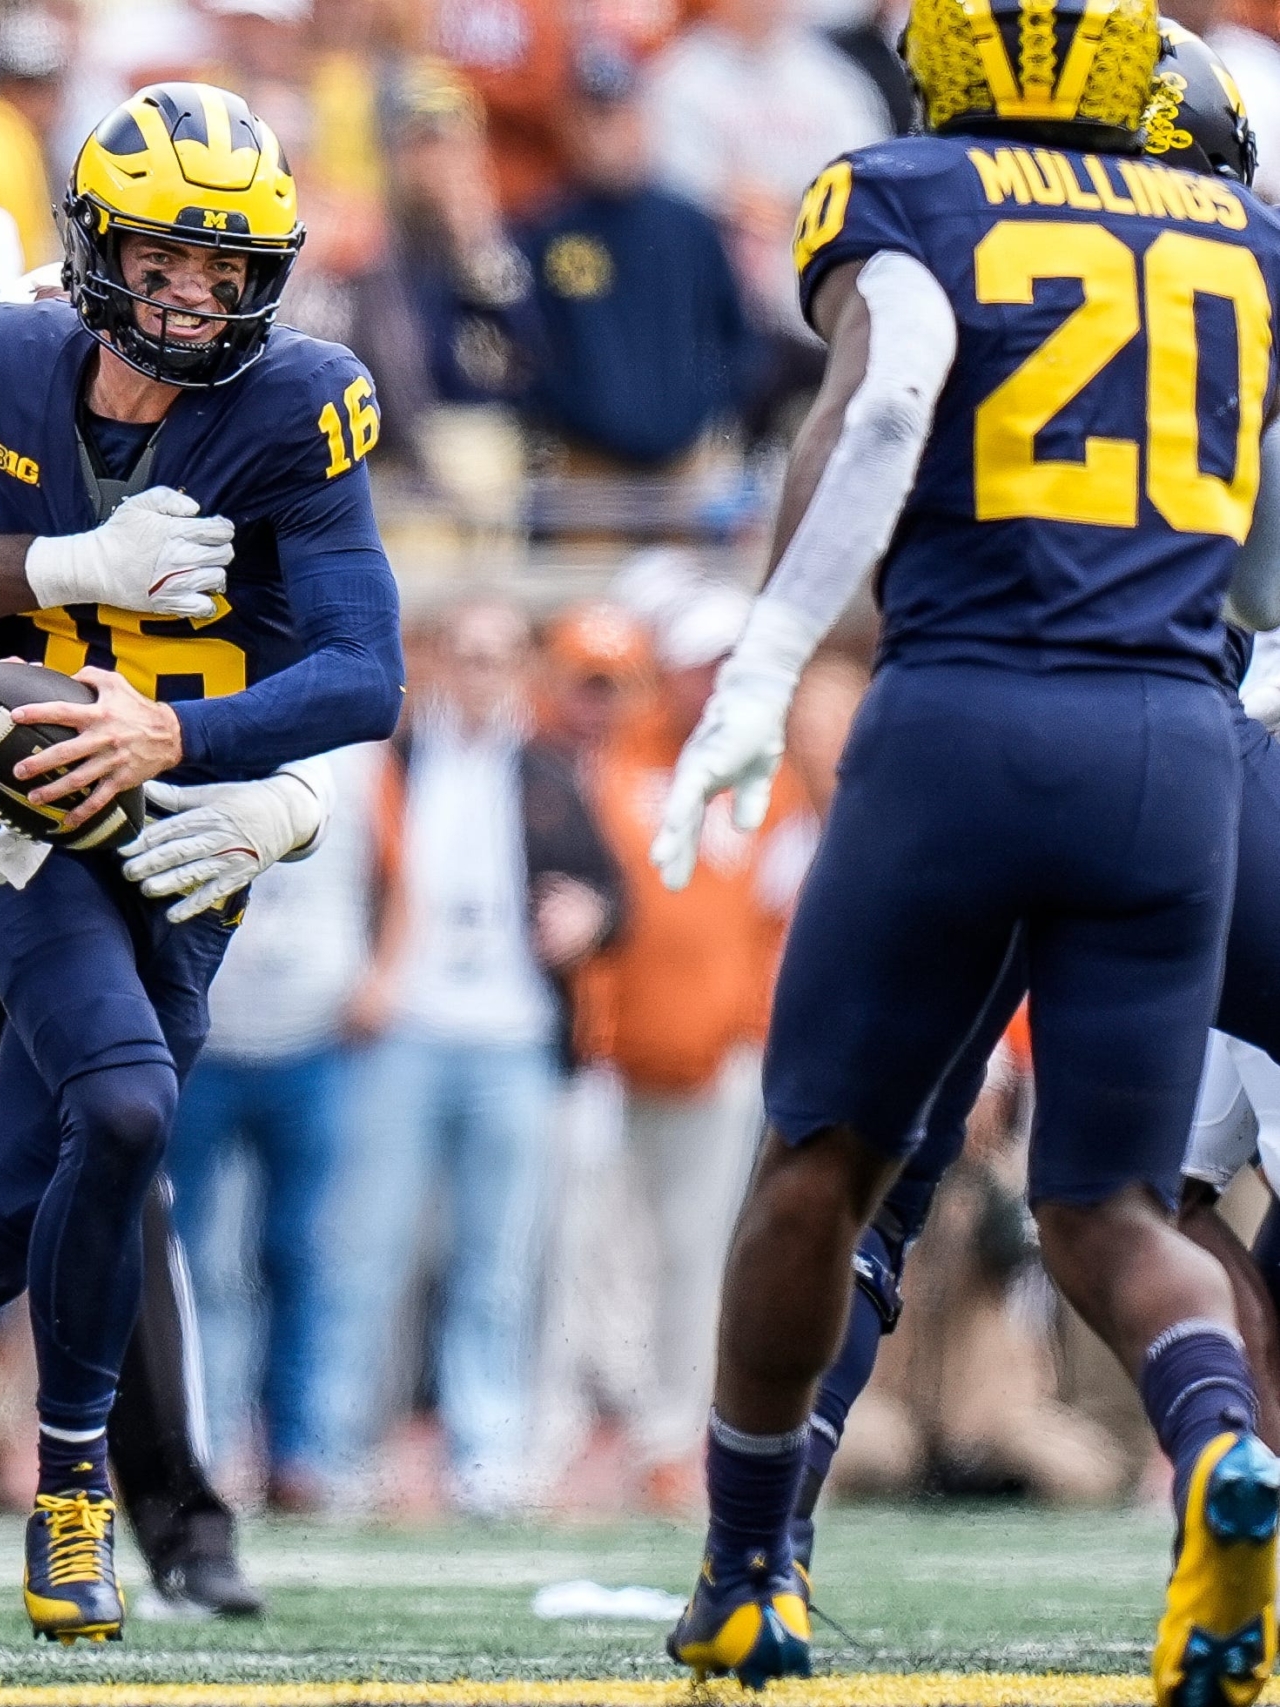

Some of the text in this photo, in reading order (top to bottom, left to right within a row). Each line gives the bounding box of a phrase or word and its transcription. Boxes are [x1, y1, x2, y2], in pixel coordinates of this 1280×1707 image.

[203, 210, 228, 230] M
[966, 147, 1248, 231] MULLINGS
[318, 376, 379, 479] 16
[974, 220, 1272, 546] 20
